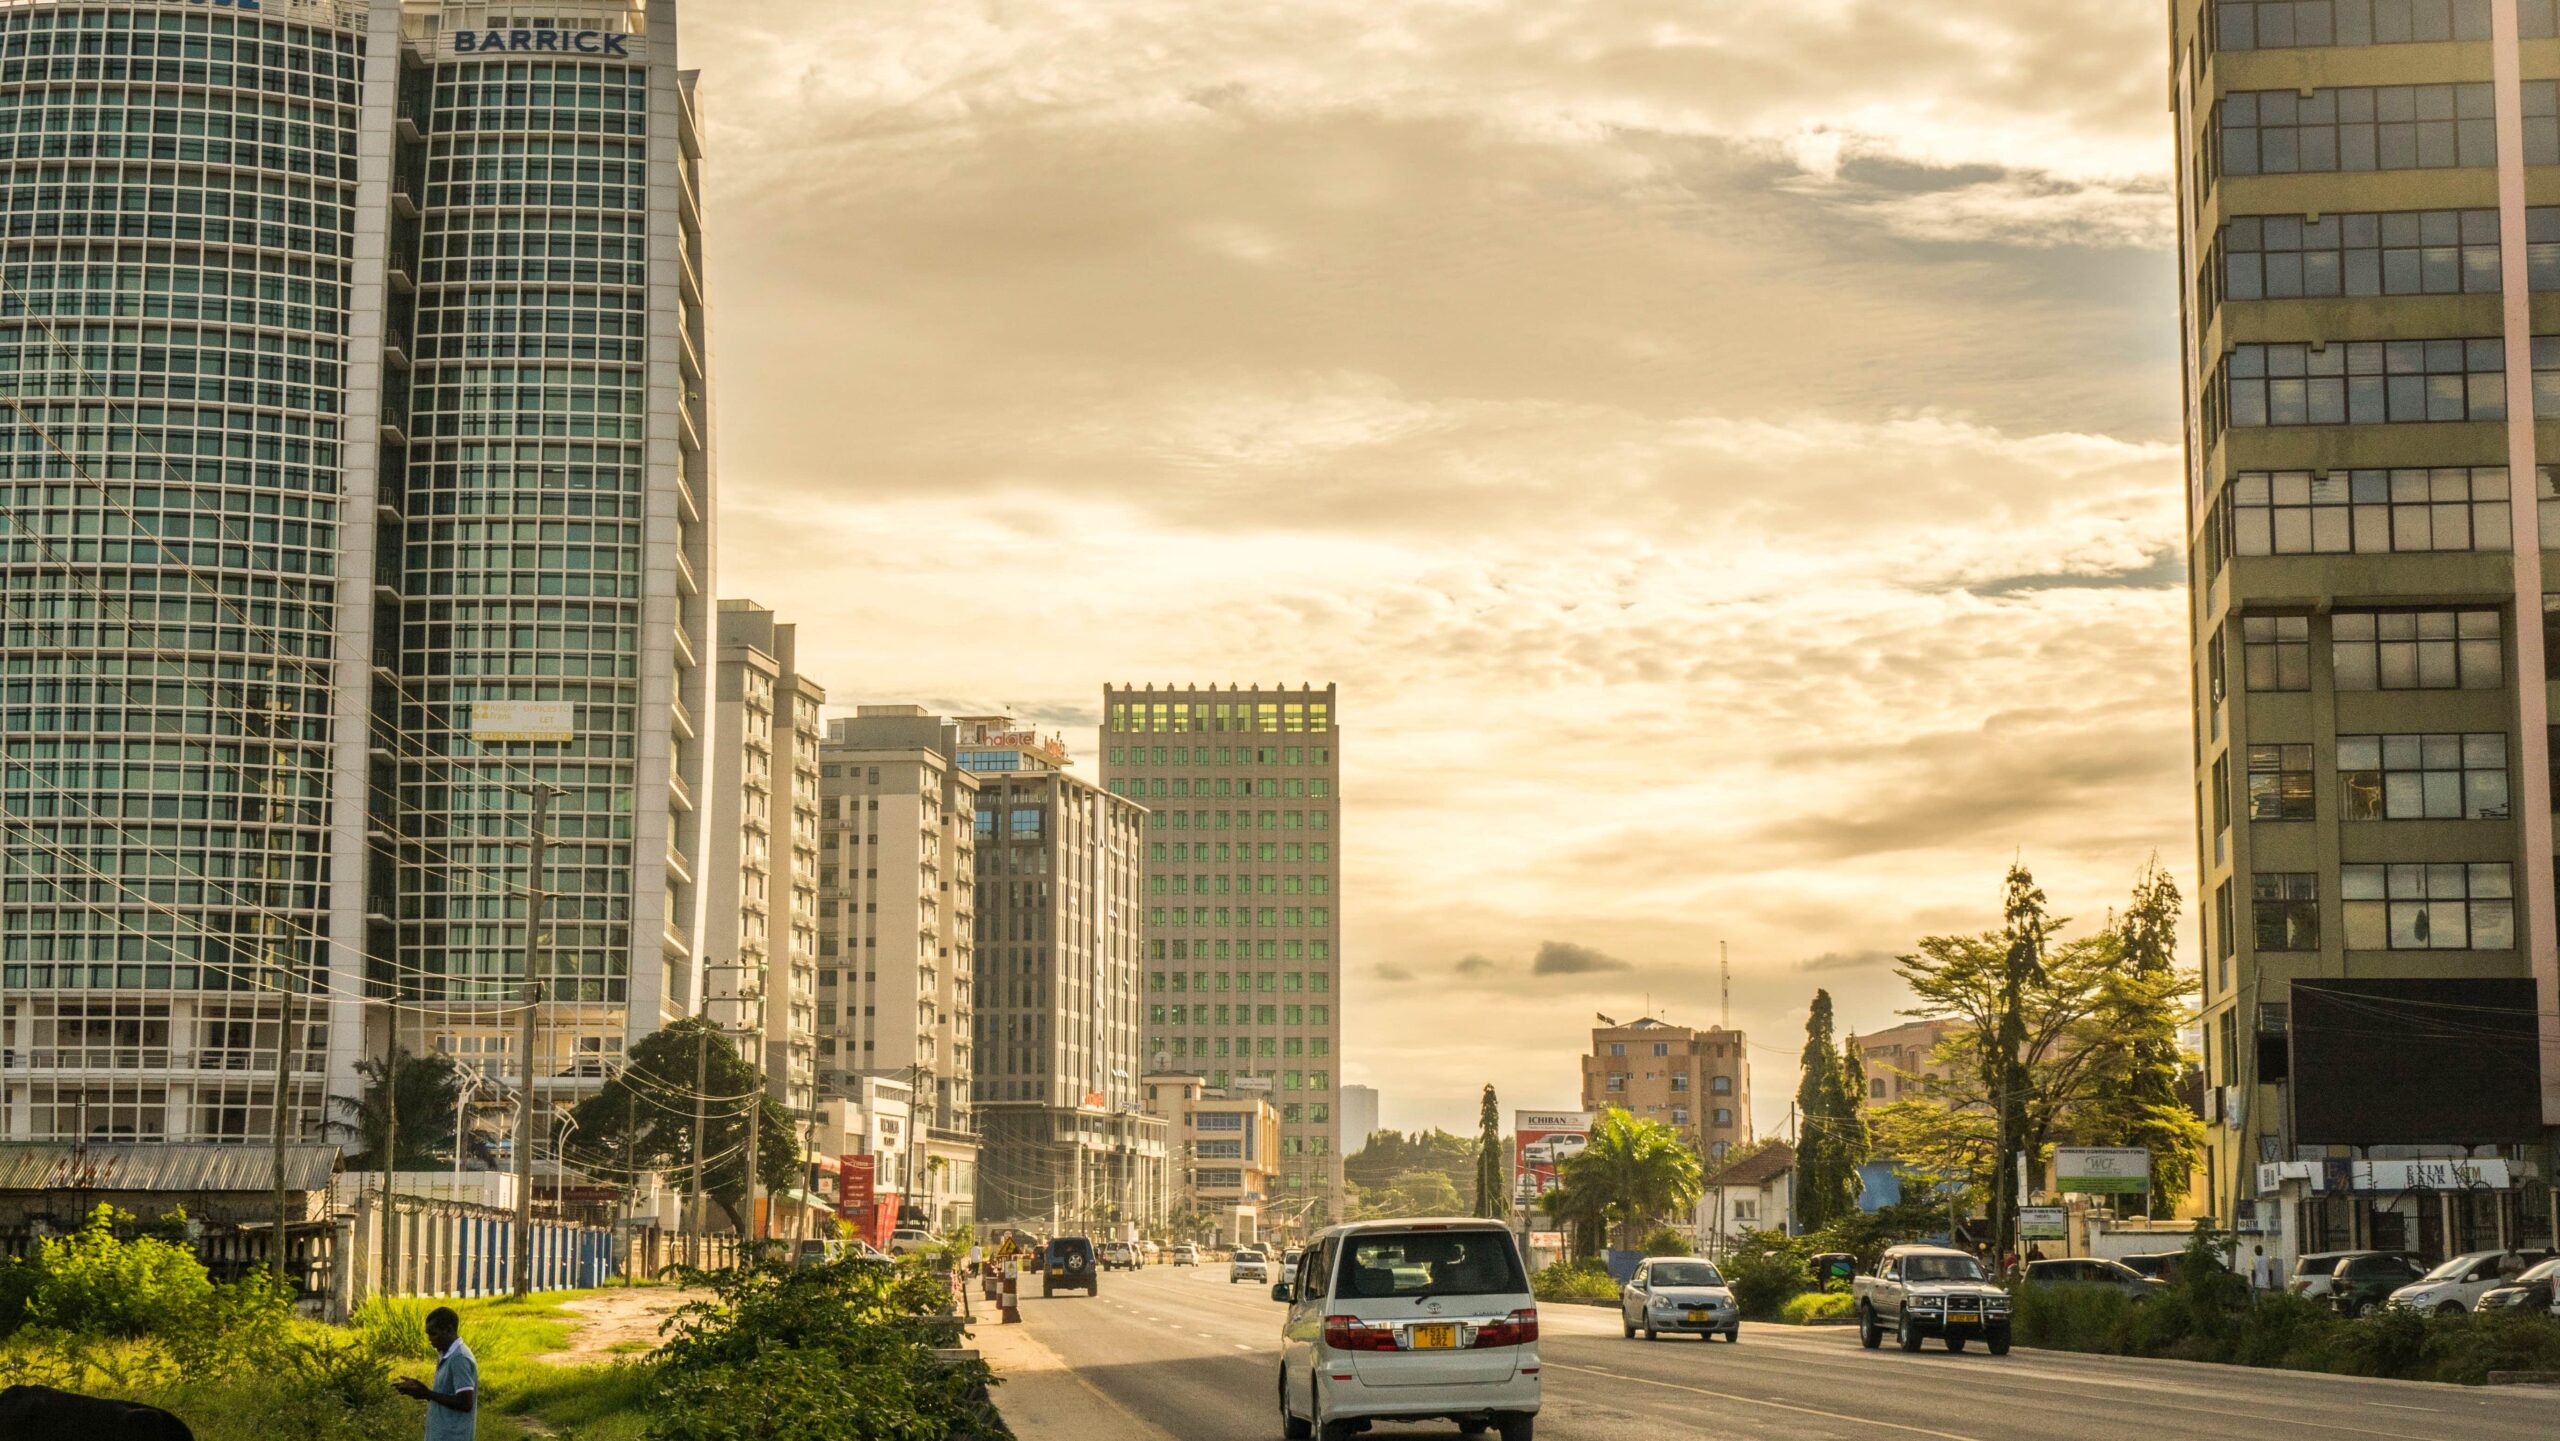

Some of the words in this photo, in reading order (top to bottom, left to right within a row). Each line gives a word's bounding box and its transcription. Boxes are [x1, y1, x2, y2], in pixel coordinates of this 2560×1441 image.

[454, 30, 629, 56] BARRICK
[523, 704, 557, 712] OFFICES
[539, 716, 554, 724] LET
[983, 731, 1035, 748] halotel
[1528, 1116, 1566, 1124] ICHIBAN
[2090, 1158, 2115, 1169] WCF
[2406, 1165, 2445, 1175] EXIM
[2407, 1175, 2446, 1185] BANK
[2246, 1220, 2259, 1228] ATM
